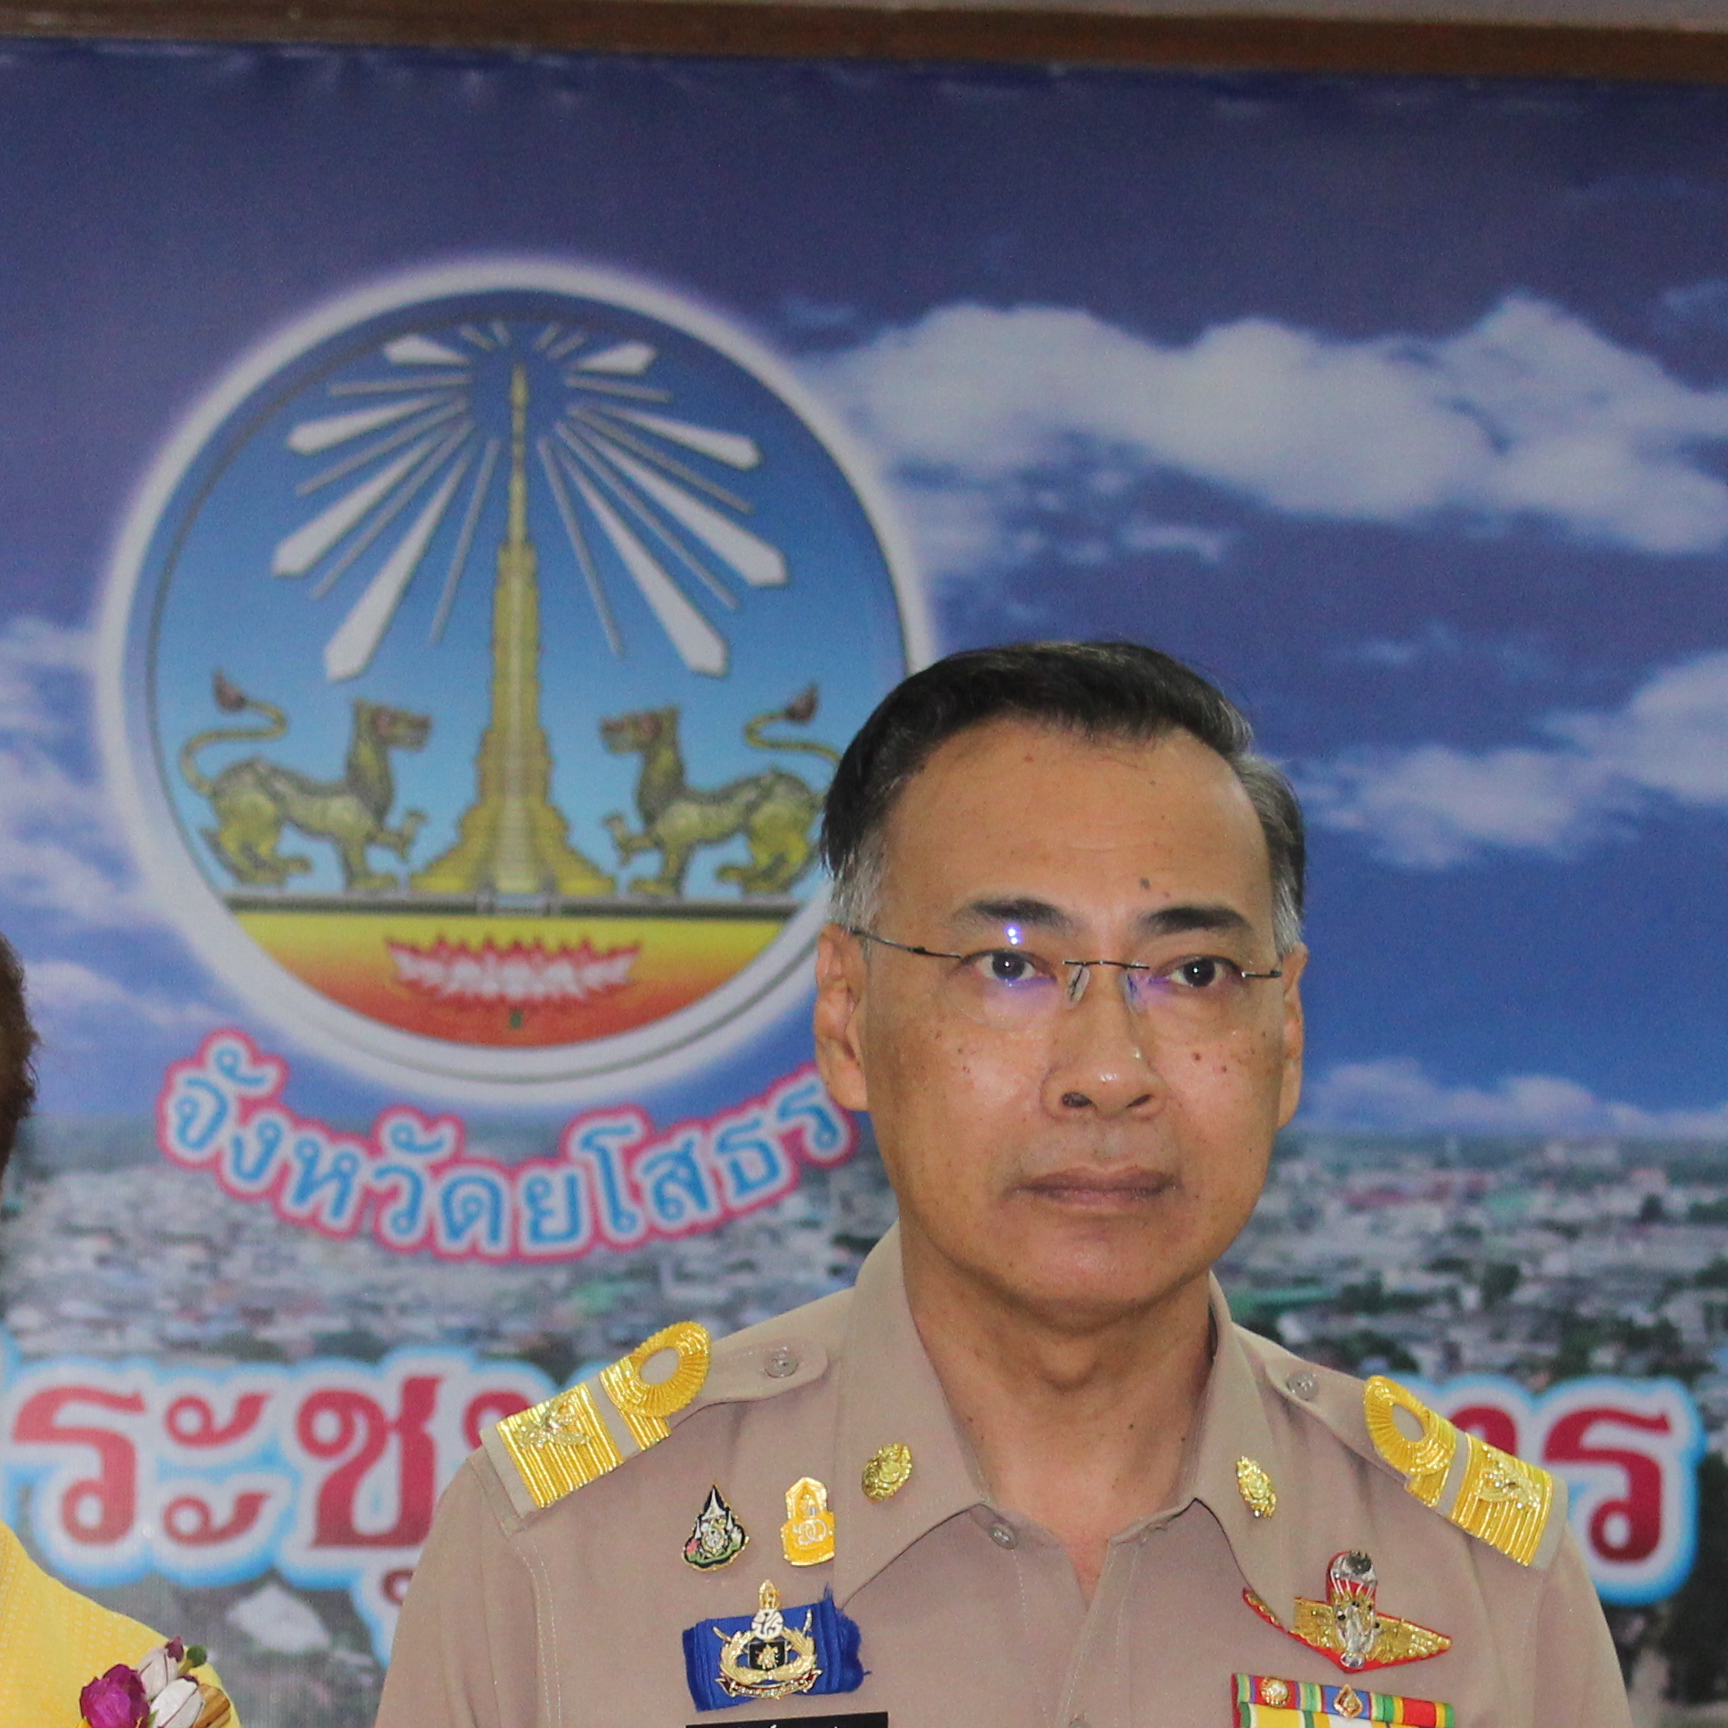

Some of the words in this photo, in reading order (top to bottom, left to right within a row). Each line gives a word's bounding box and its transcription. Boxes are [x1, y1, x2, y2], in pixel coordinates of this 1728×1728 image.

[170, 1044, 844, 1247] จังหวัดยโสธร
